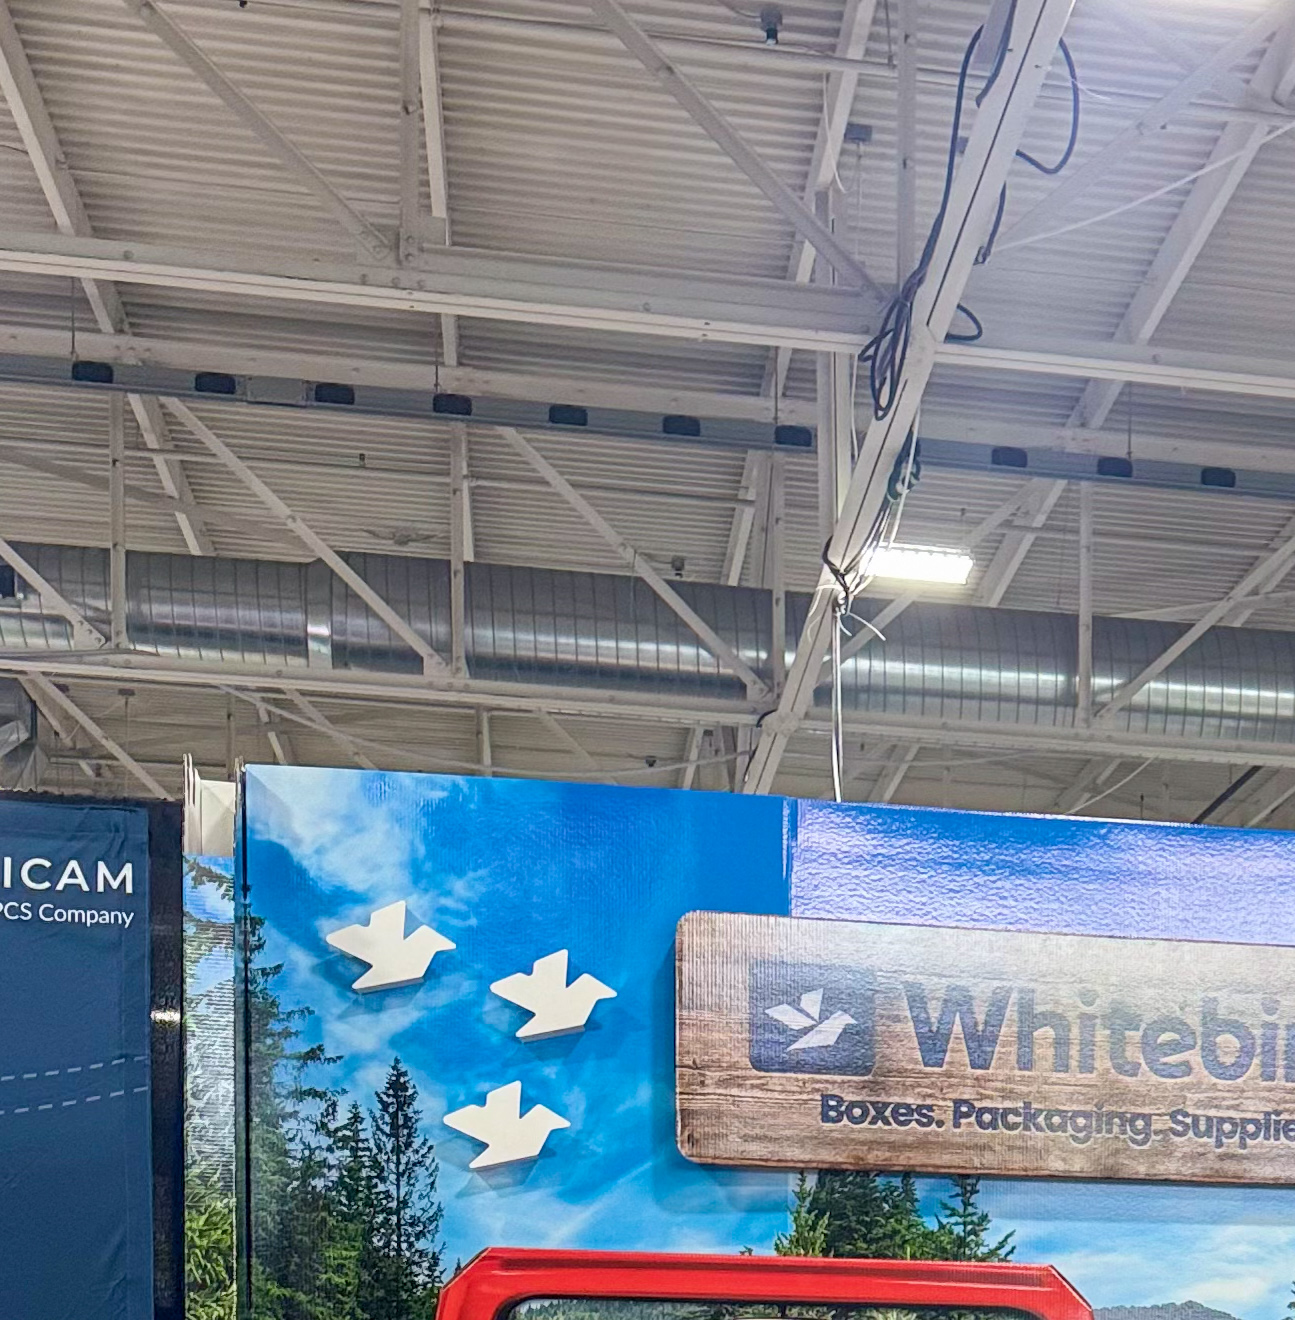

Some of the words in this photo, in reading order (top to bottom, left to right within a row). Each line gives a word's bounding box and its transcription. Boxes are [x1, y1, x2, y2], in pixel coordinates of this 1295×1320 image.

[3, 856, 133, 895] ICAM
[38, 903, 134, 929] Company
[820, 1093, 945, 1129] Boxes.
[951, 1098, 1166, 1147] Packaging.
